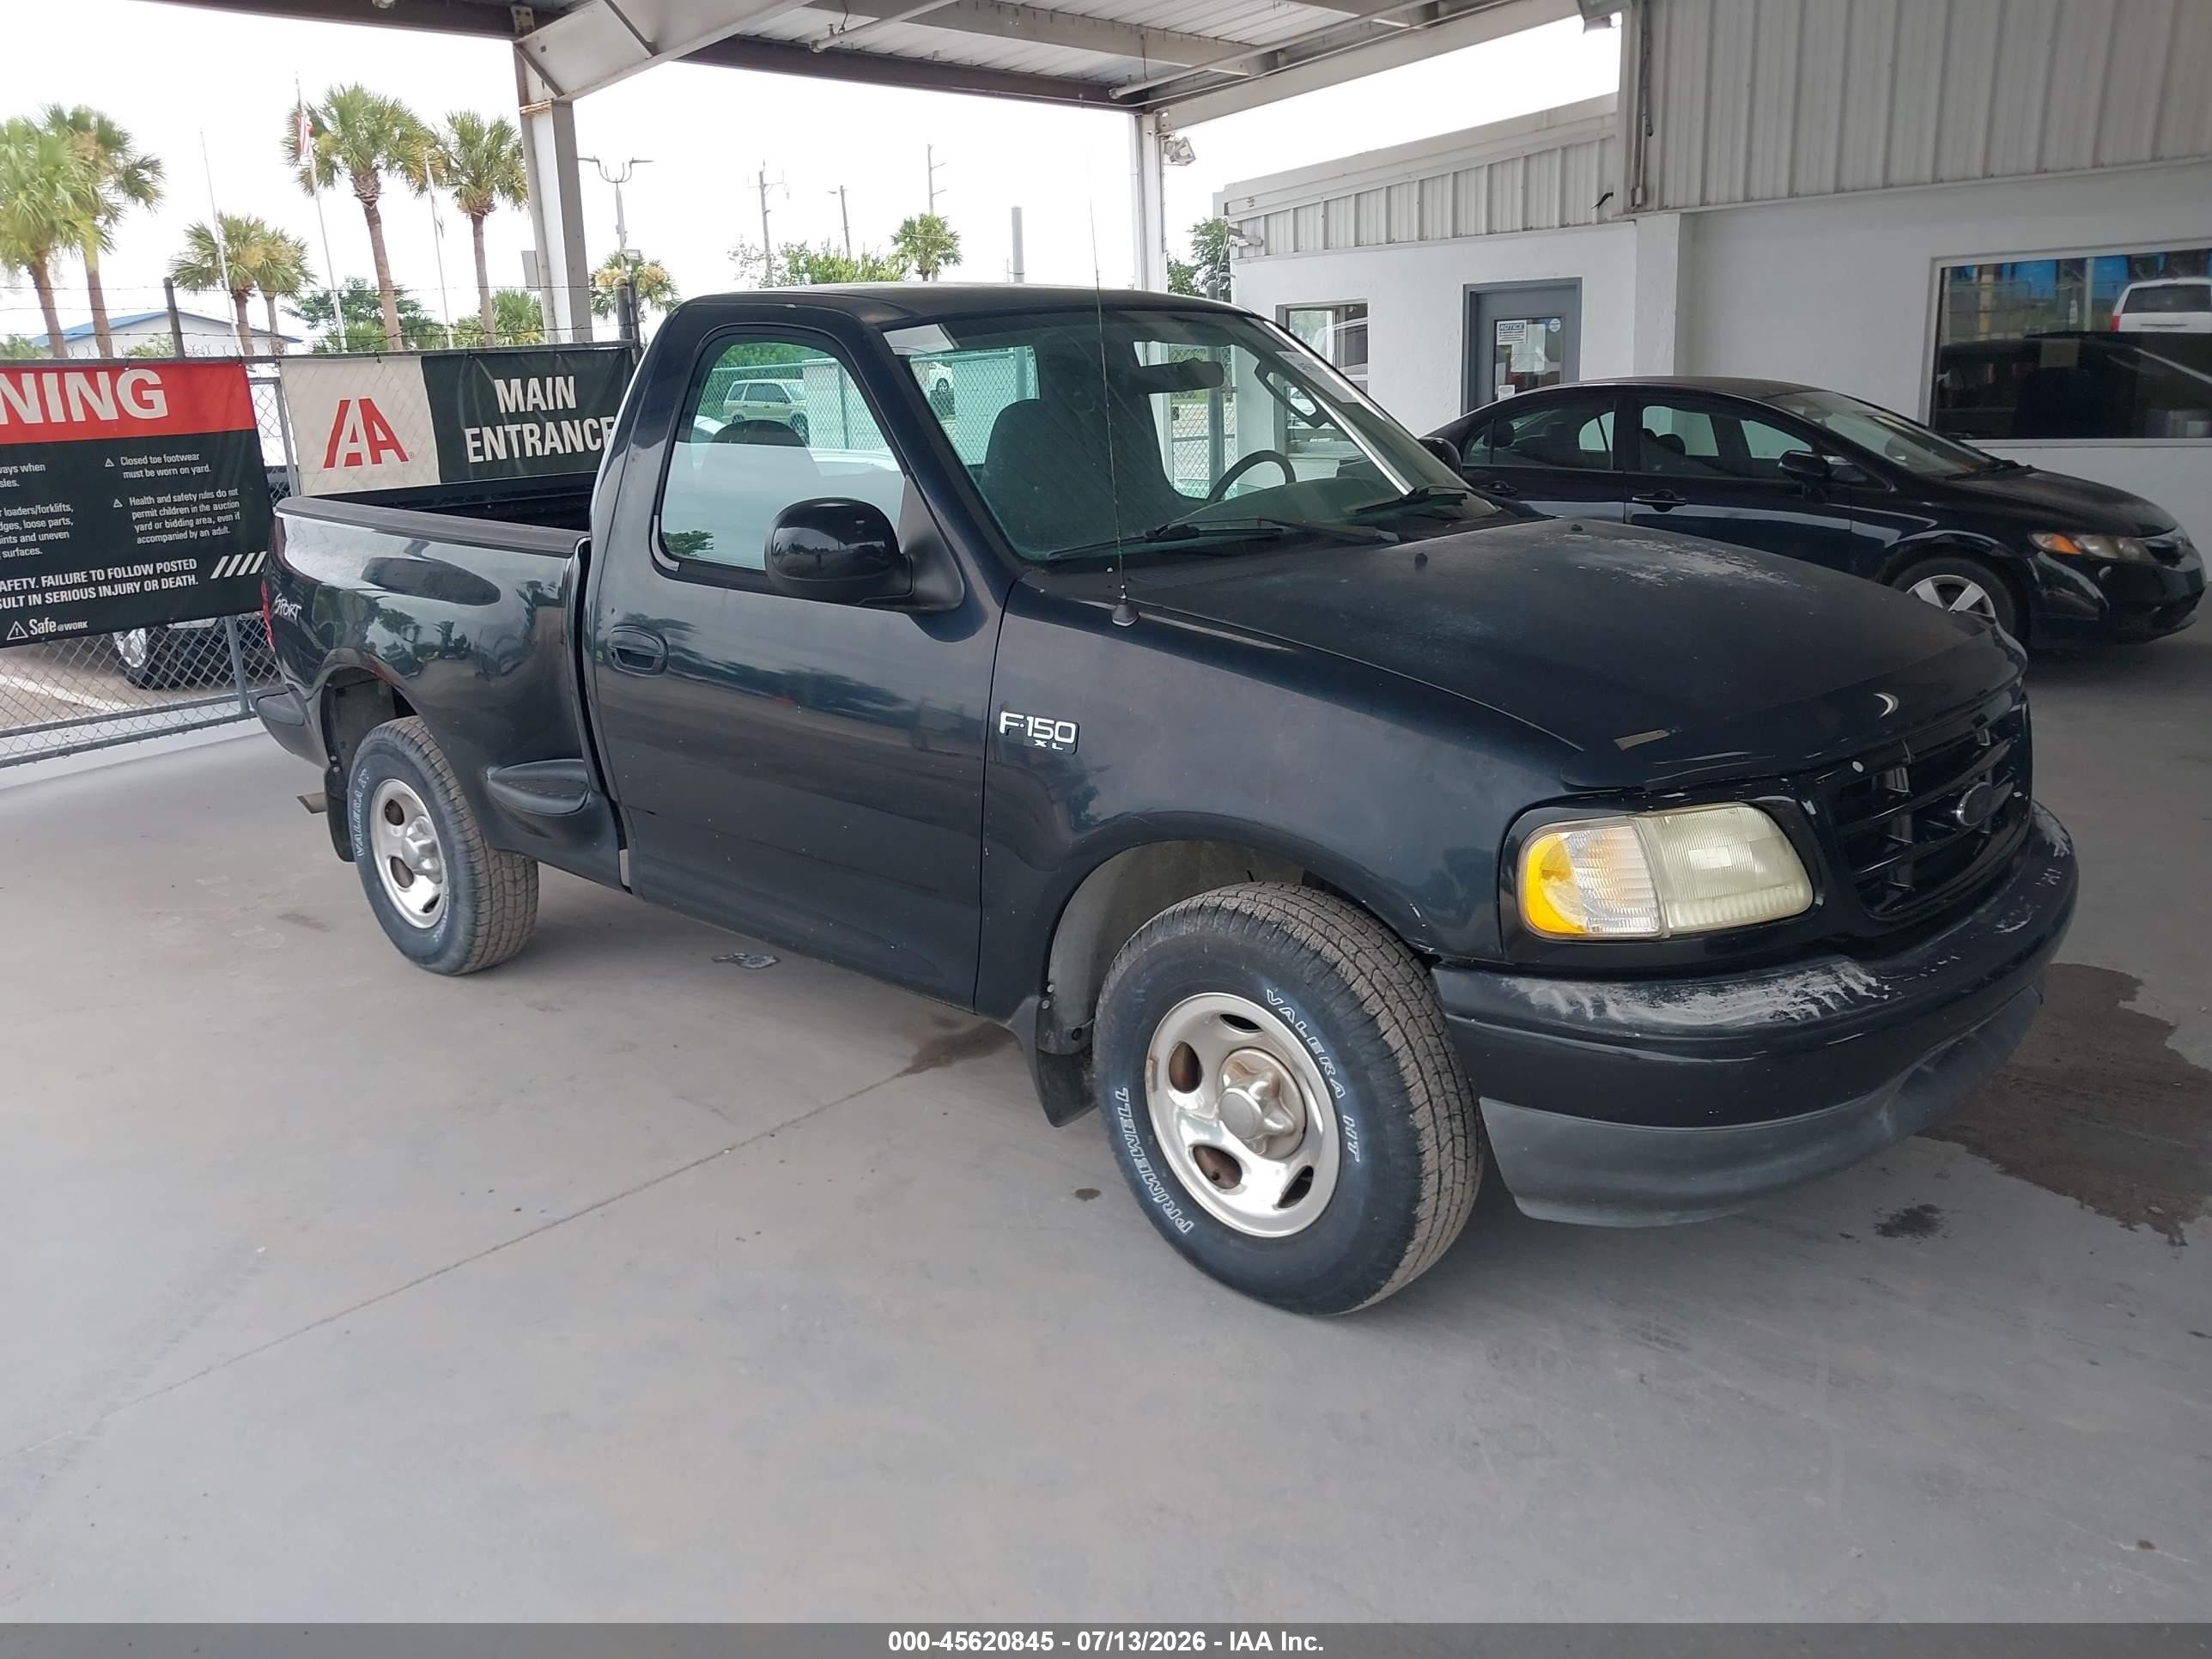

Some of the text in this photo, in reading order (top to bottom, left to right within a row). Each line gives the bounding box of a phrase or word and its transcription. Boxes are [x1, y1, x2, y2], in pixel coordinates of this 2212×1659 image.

[494, 375, 577, 414] MAIN
[20, 463, 46, 472] when
[120, 455, 148, 466] Closed
[164, 453, 200, 463] footwear
[123, 470, 144, 479] must
[145, 469, 155, 477] be
[191, 464, 212, 475] yard.
[129, 488, 239, 507] Health and safety rules do not
[3, 503, 74, 517] loaders/forklifts,
[131, 500, 240, 520] permit children in the auction
[22, 519, 46, 529] loose
[48, 518, 74, 529] parts,
[134, 512, 240, 534] yard or bidding area, even if
[20, 532, 37, 543] and
[39, 531, 70, 541] uneven
[137, 526, 231, 544] accompanied by an adult.
[2, 547, 43, 558] surfaces.
[41, 571, 88, 587] FAILURE
[89, 569, 106, 581] TO
[107, 563, 155, 579] FOLLOW
[155, 558, 198, 573] POSTED
[27, 593, 42, 606] IN
[45, 586, 97, 604] SERIOUS
[99, 581, 141, 598] INJURY
[144, 580, 160, 592] OR
[161, 574, 199, 589] DEATH.
[274, 592, 302, 620] SPORT
[1266, 988, 1346, 1099] VALERA
[1115, 1087, 1195, 1235] PRIMEWELL
